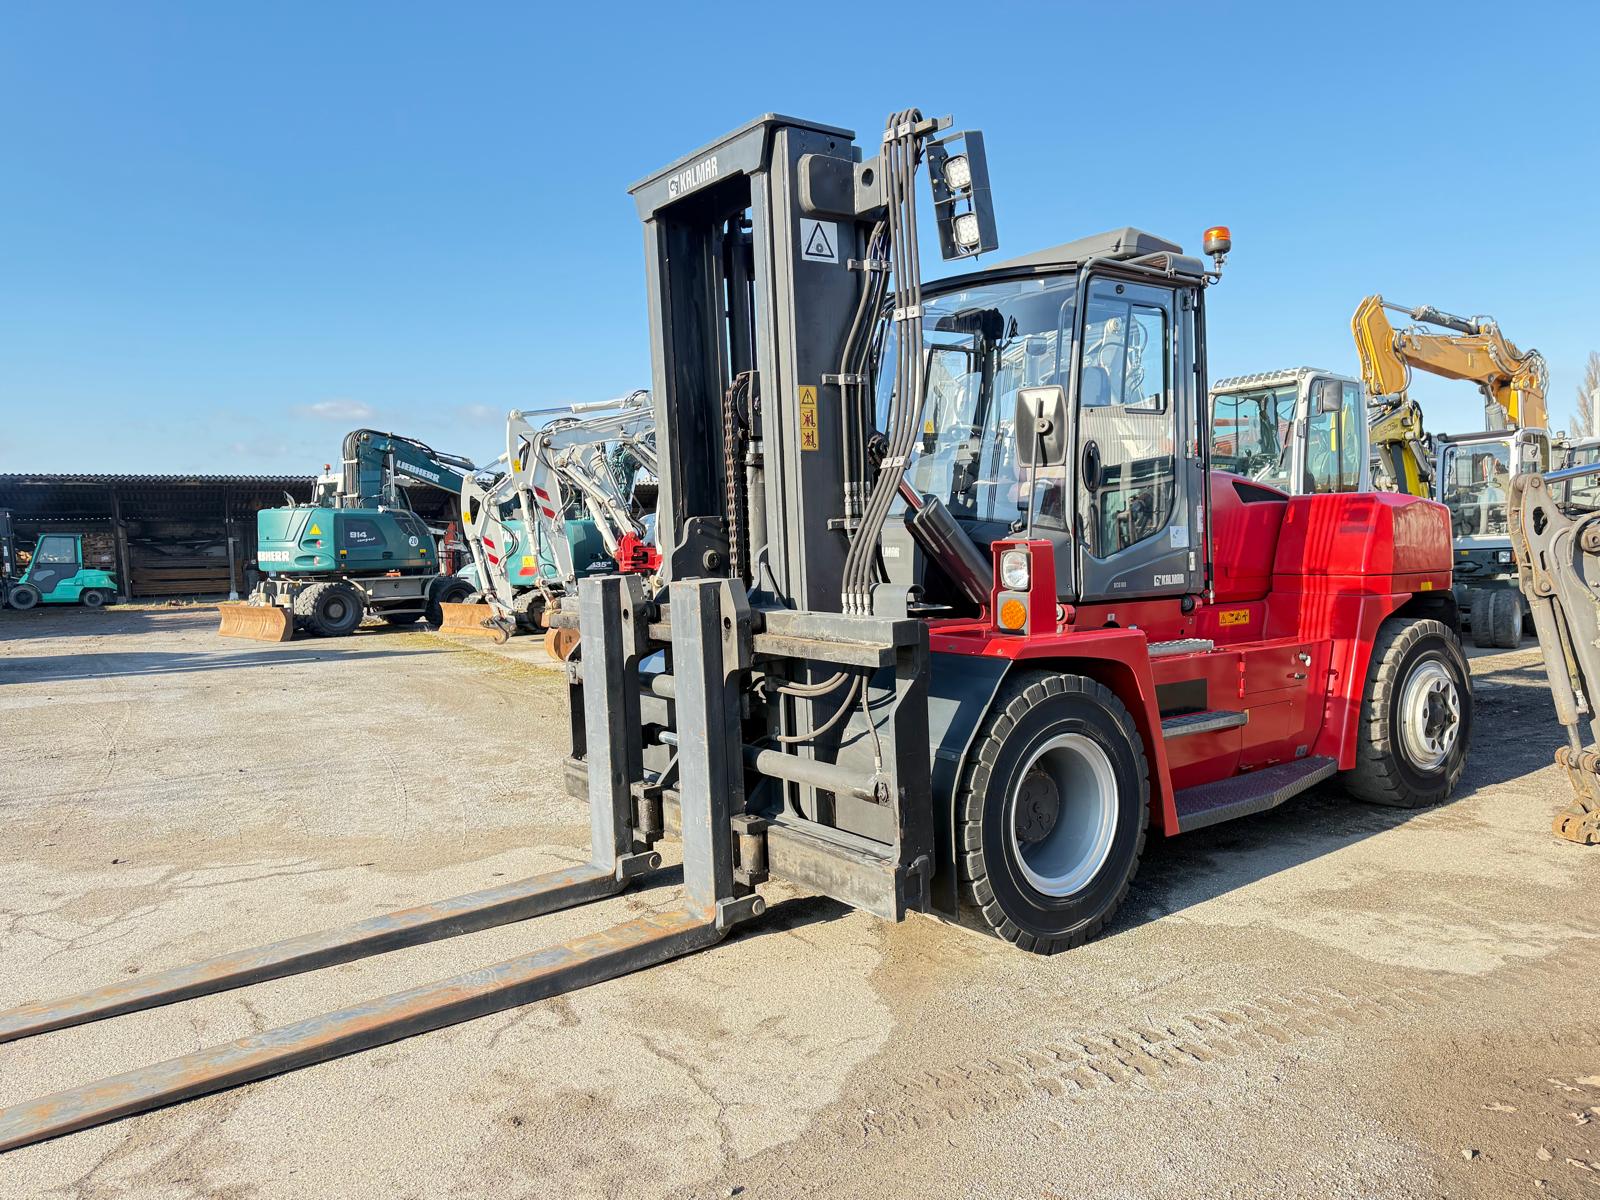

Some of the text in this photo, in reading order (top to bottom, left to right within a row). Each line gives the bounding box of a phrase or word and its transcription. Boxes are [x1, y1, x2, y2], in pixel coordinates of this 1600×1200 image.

[680, 156, 718, 193] KALMAR
[396, 459, 440, 483] LIEBHERR
[1161, 574, 1185, 585] KALMAR
